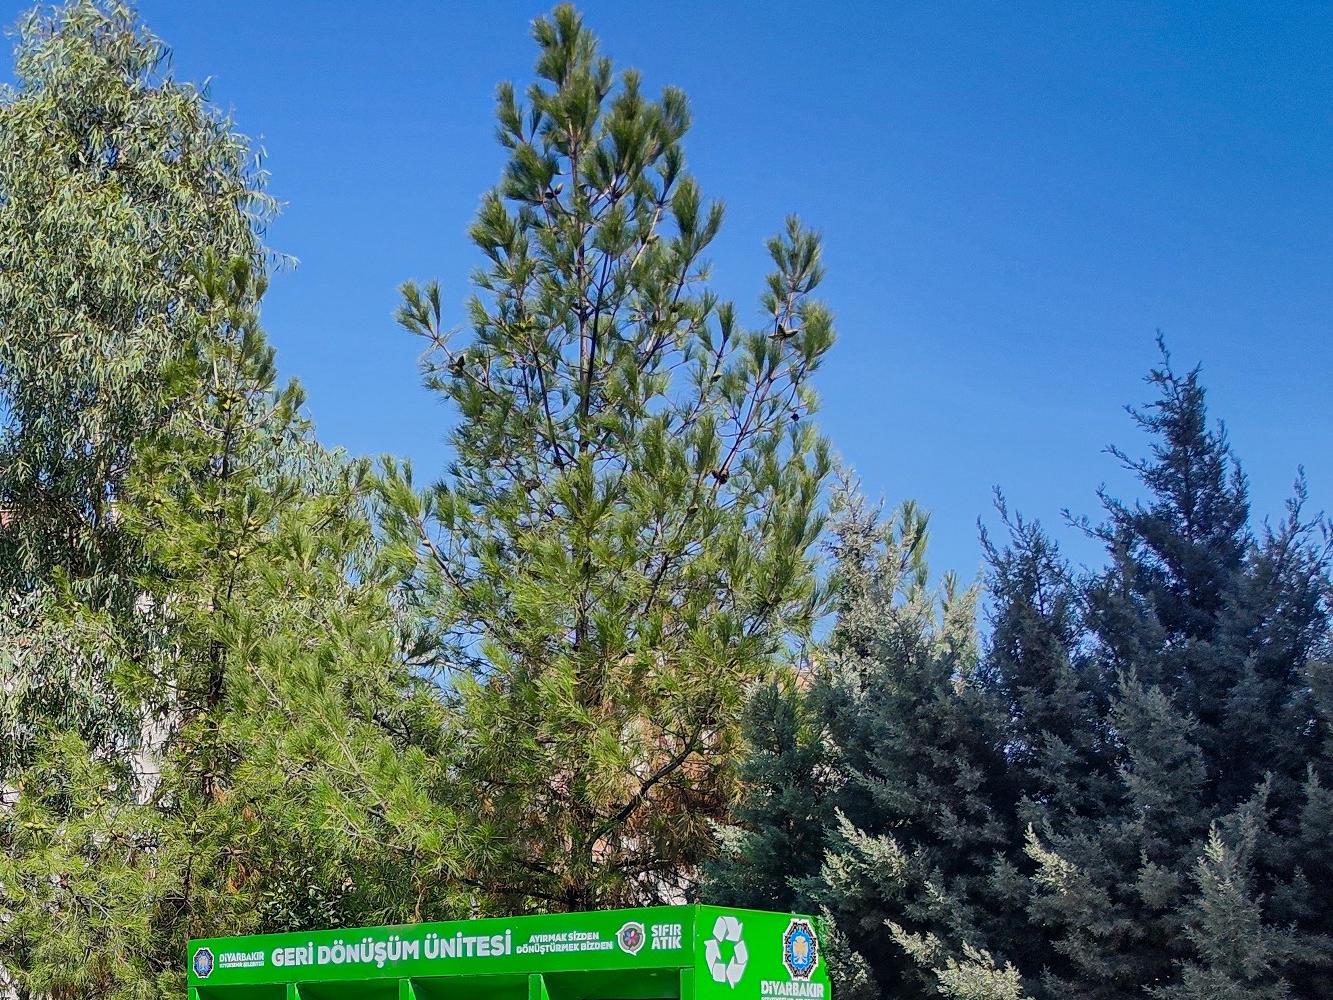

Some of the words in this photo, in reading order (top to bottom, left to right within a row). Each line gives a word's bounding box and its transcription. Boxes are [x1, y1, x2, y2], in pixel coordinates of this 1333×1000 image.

[528, 934, 567, 944] AYIRMAK
[568, 931, 600, 941] SİZDEN
[650, 924, 682, 937] SIFIR
[271, 941, 314, 967] GERİ
[317, 936, 420, 969] DÖNÜŞÜM
[424, 929, 512, 959] ÜNİTESİ
[516, 942, 580, 955] DÖNÜŞTÜRMEK
[580, 941, 613, 951] BİZDEN
[651, 936, 683, 950] ATIK
